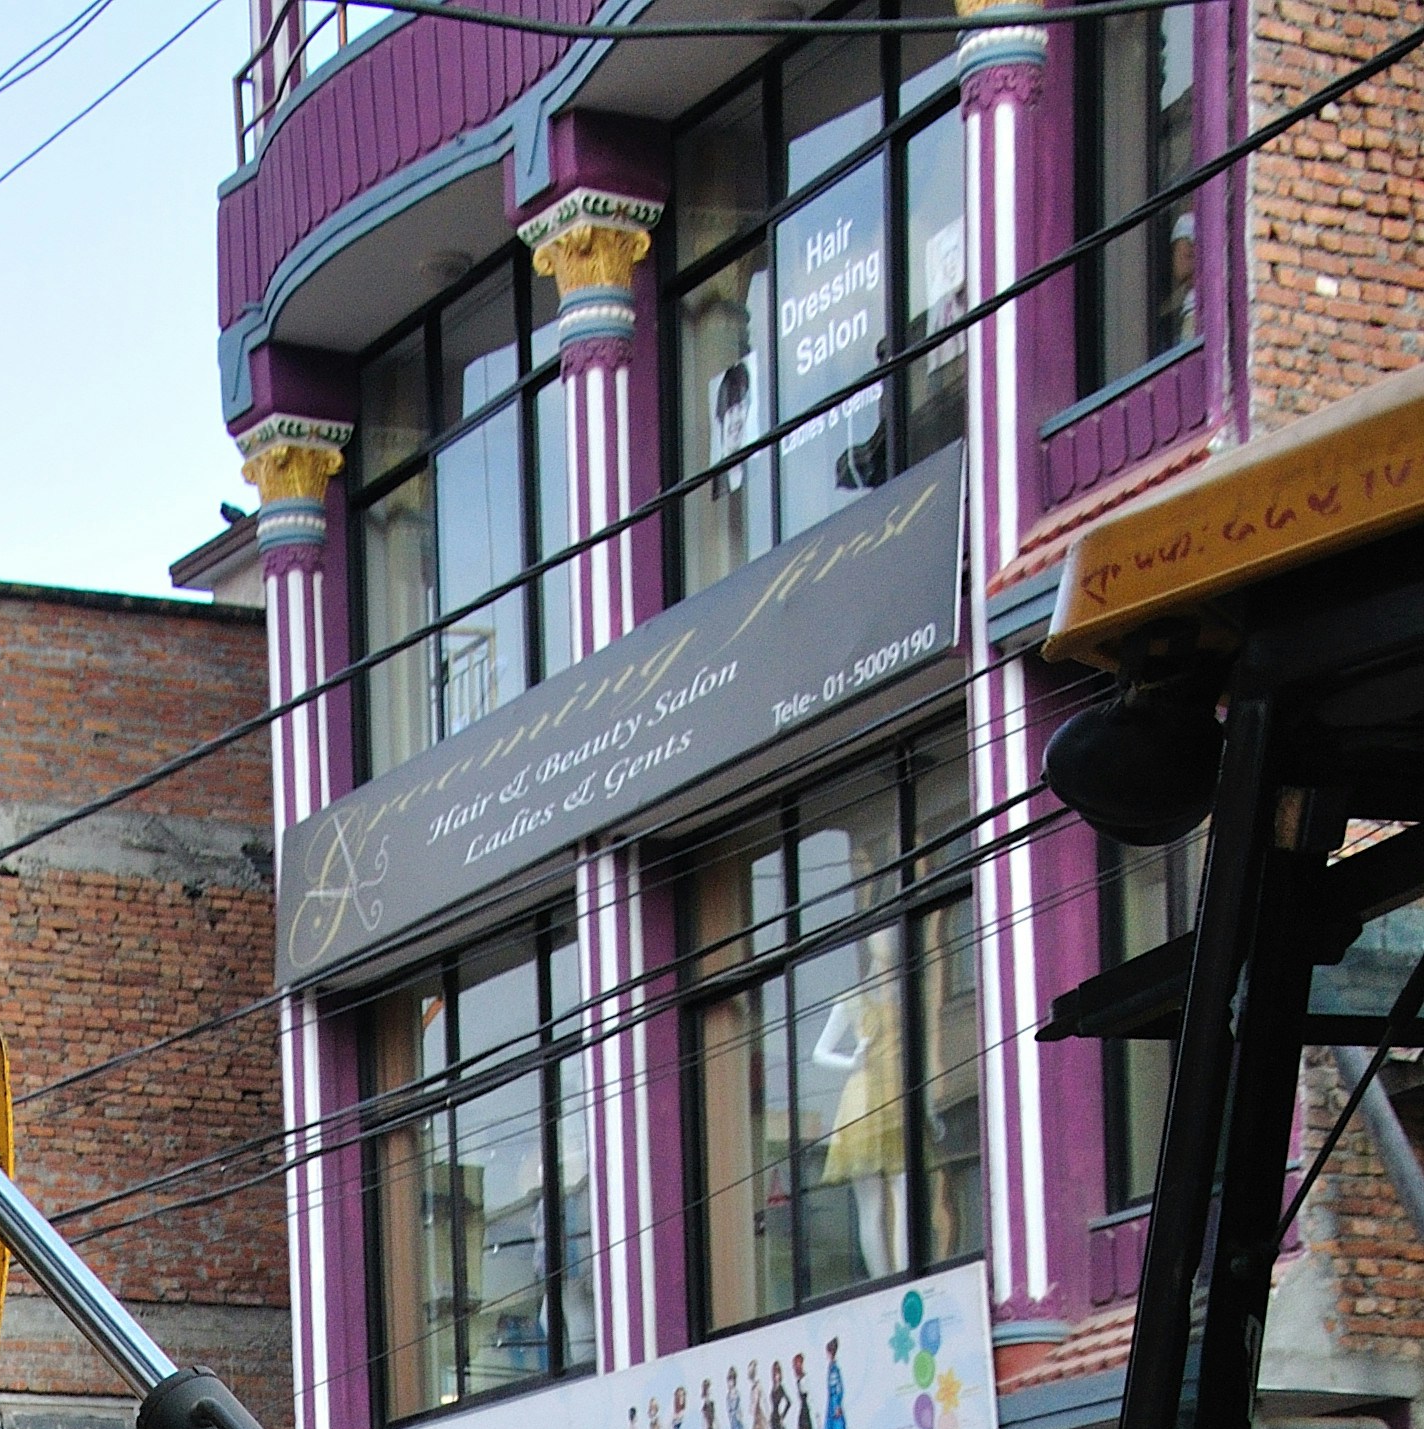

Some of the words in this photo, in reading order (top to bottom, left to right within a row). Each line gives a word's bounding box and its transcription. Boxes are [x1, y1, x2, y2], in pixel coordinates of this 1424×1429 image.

[806, 218, 853, 274] Hair
[781, 250, 880, 338] Dressing
[796, 308, 869, 377] Salon
[823, 622, 936, 702] 01-5009190
[427, 790, 494, 846] Hair
[499, 764, 532, 804] &
[534, 713, 643, 786] Beauty
[647, 660, 738, 728] Salon
[463, 802, 555, 867] Ladies
[563, 771, 598, 812] &
[604, 729, 694, 799] Gents
